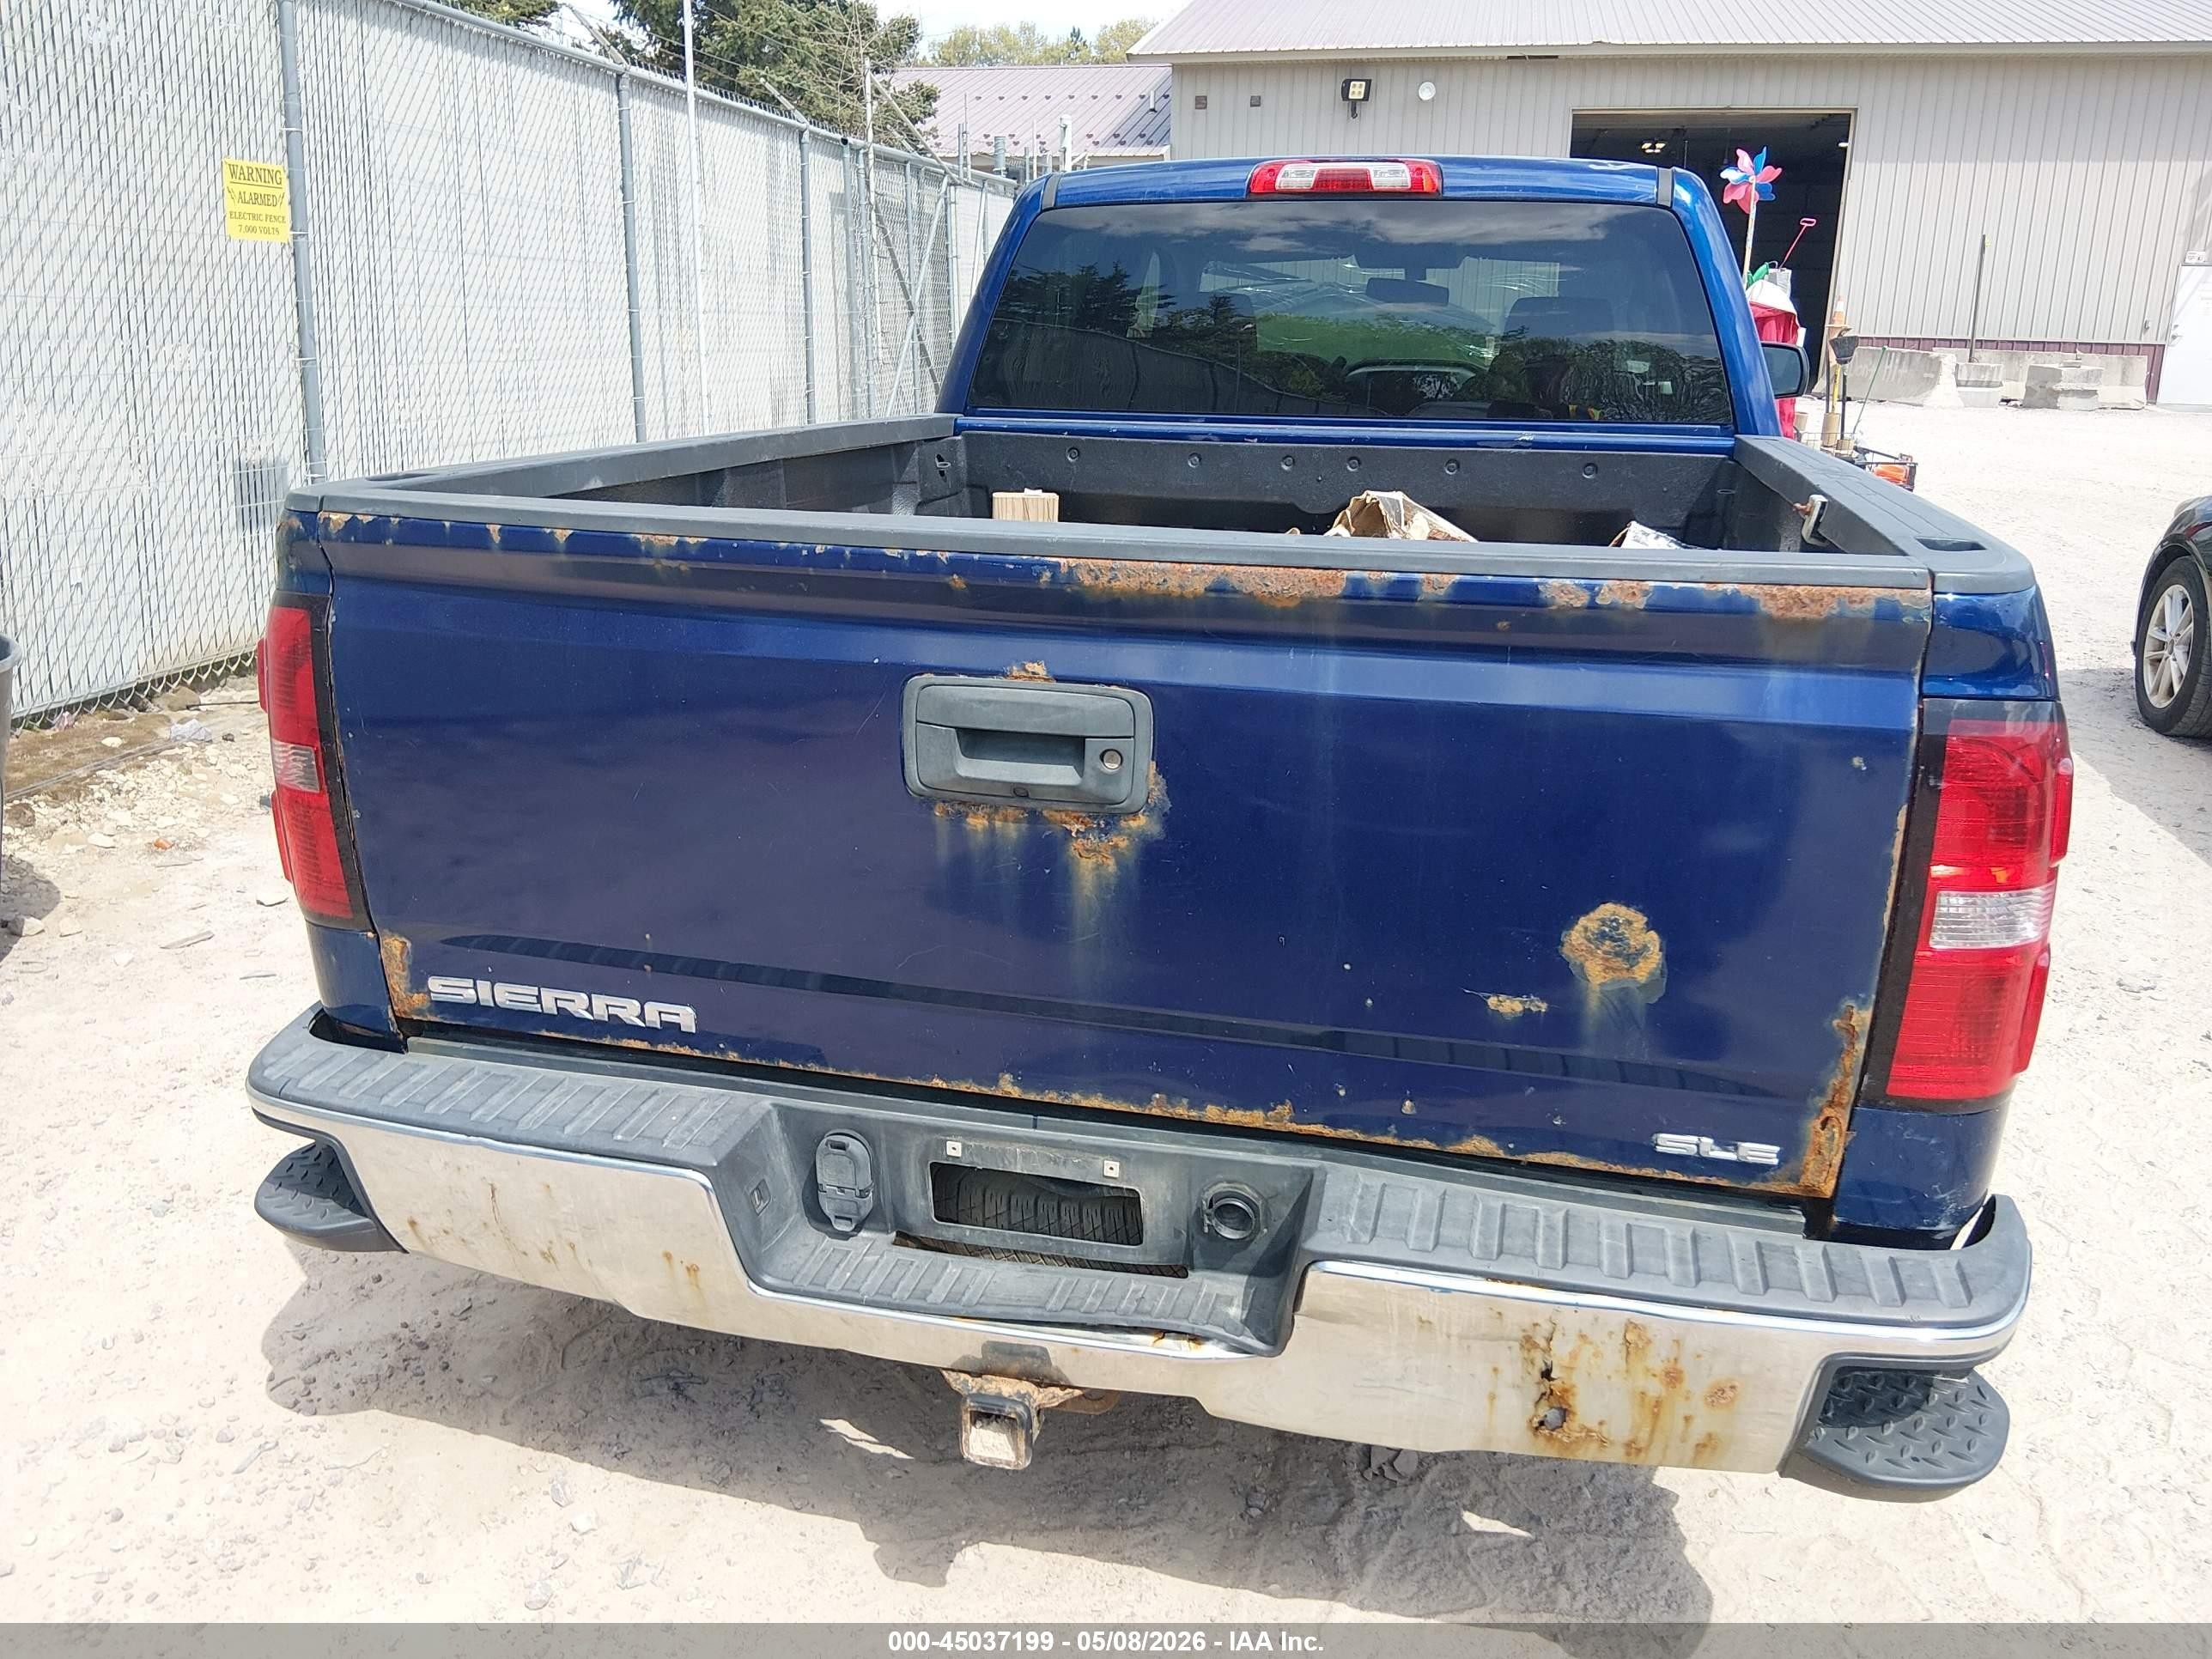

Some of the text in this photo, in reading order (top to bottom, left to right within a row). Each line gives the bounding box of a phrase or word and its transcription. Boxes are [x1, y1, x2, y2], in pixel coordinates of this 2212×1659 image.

[228, 163, 283, 185] WARNING
[237, 191, 277, 207] ALARMED
[229, 211, 286, 224] ELECTRIC FENCE
[258, 226, 280, 235] VOLTS
[428, 975, 697, 1034] SIERRA
[1653, 1133, 1781, 1165] SLE
